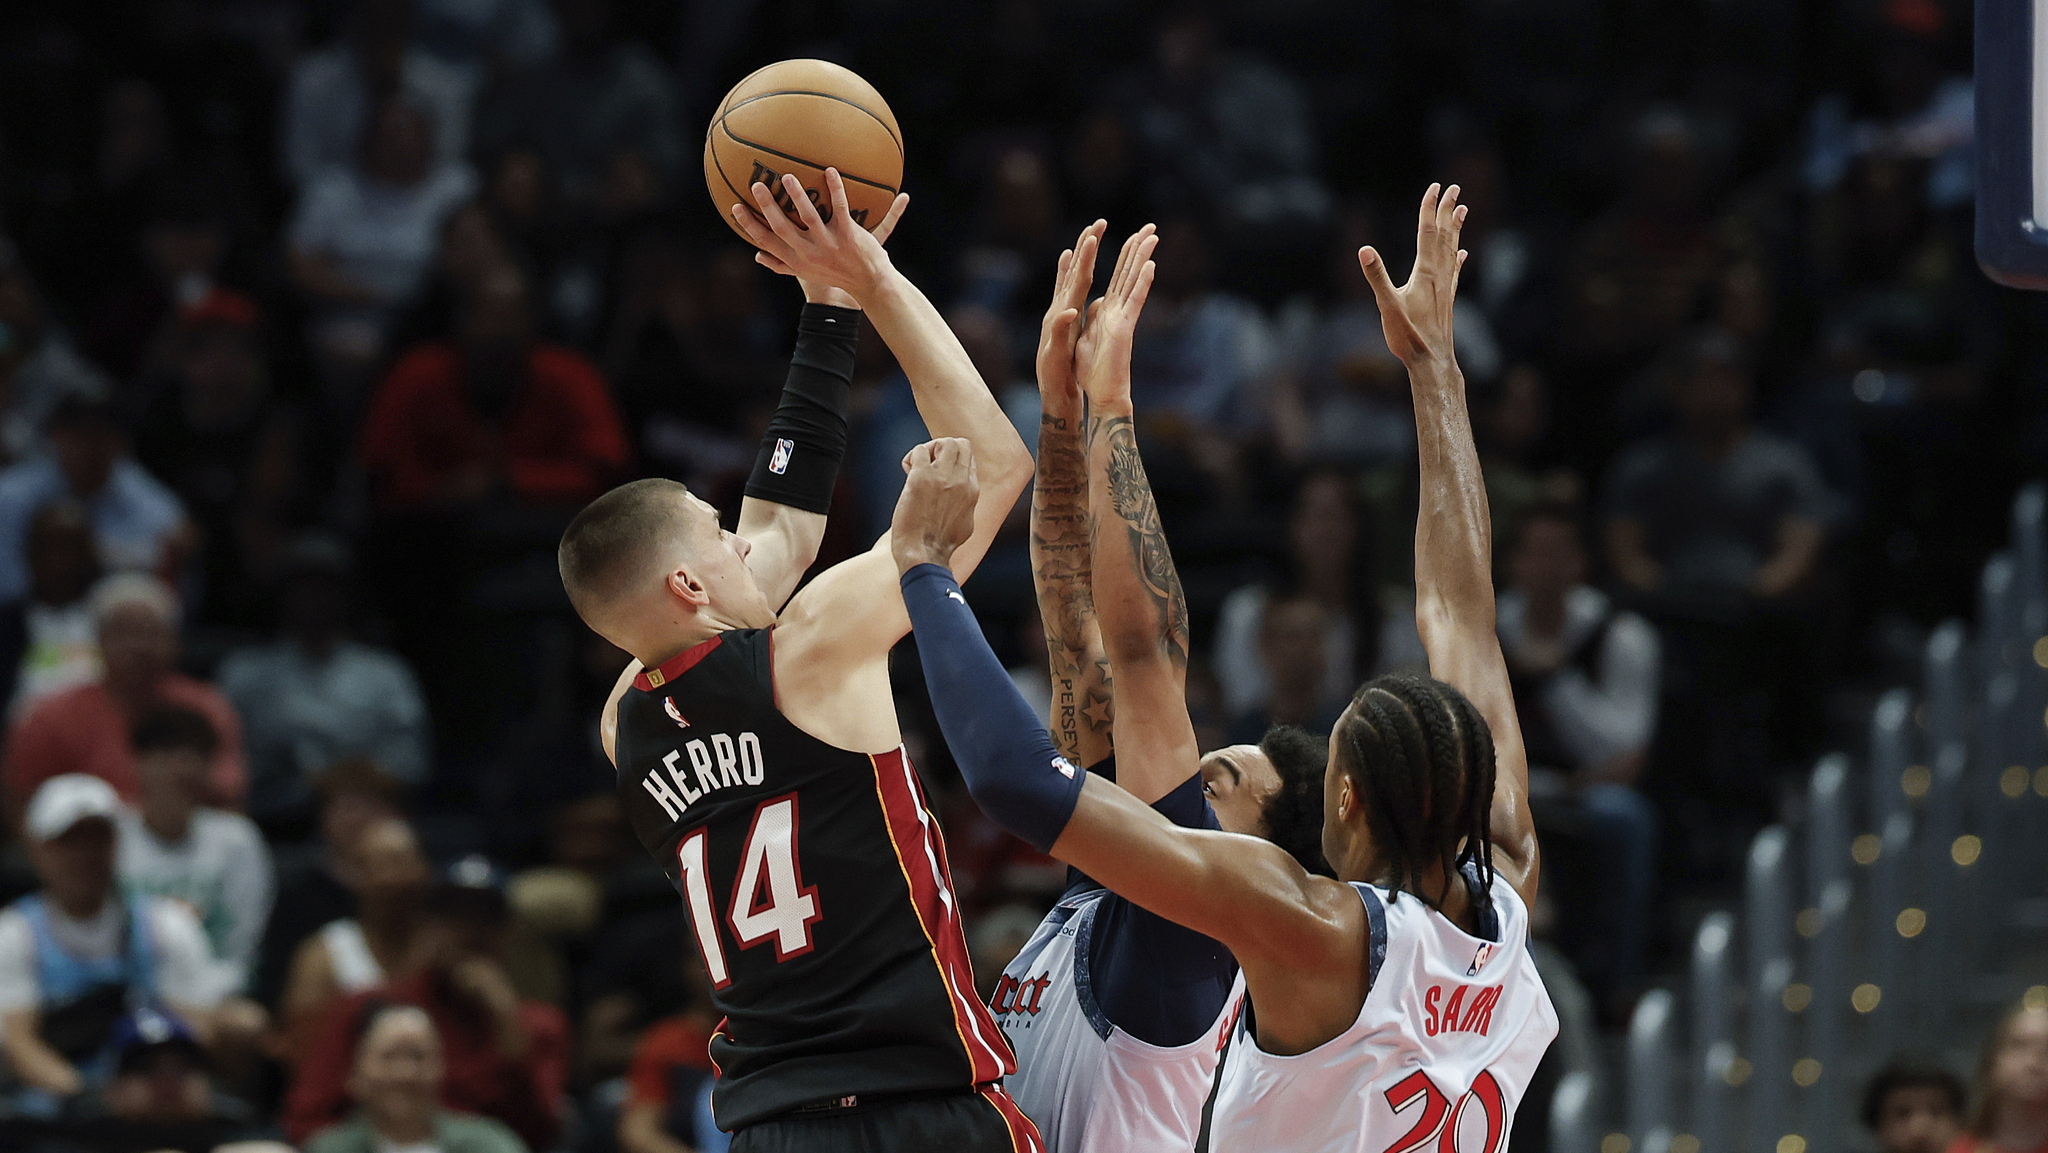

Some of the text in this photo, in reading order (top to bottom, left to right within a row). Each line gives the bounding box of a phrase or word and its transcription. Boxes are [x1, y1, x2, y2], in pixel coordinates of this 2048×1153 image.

[642, 732, 765, 823] HERRO
[676, 791, 823, 991] 14
[1425, 984, 1503, 1037] SARR
[1384, 1068, 1508, 1153] 20
